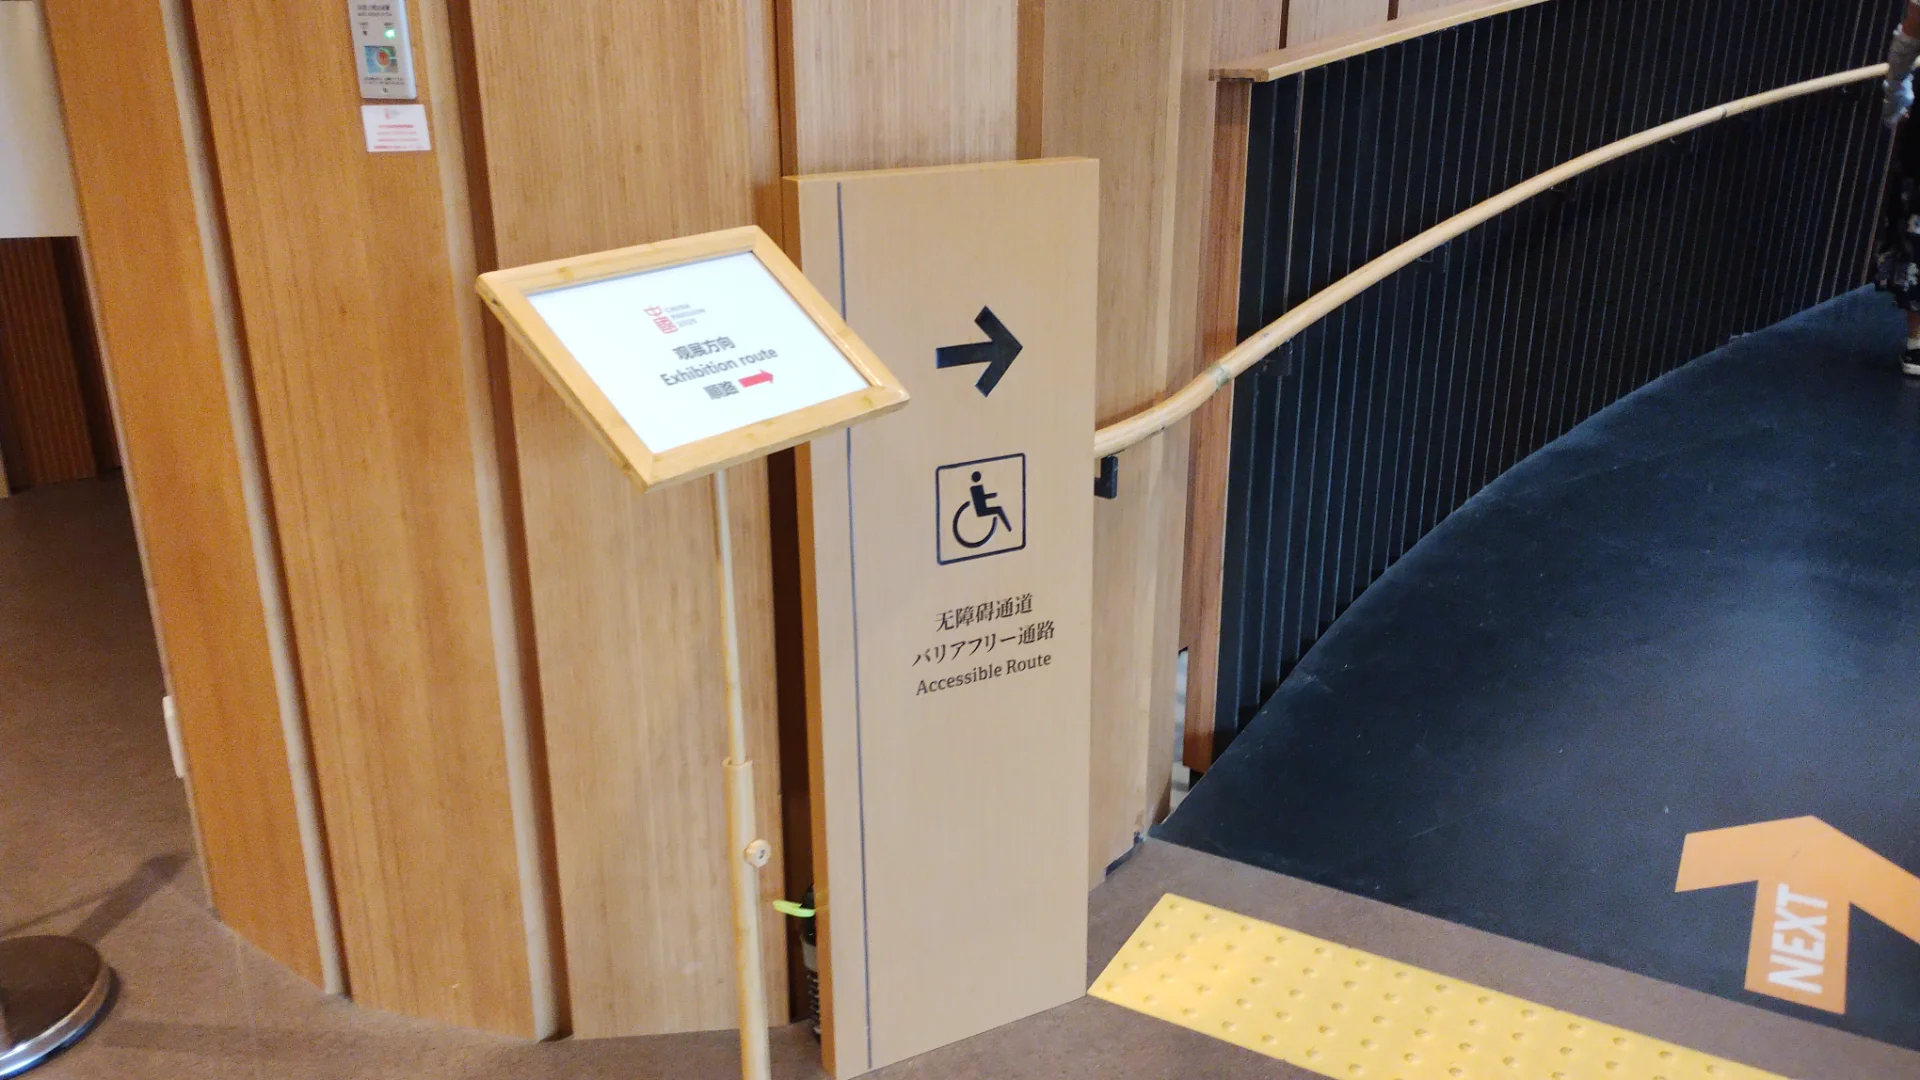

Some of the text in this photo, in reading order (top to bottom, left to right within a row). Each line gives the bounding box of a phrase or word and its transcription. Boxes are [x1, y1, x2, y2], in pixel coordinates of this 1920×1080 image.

[659, 348, 778, 386] Exhibition route
[672, 336, 736, 360] 观展方向
[935, 592, 1033, 632] 无障碍通道
[911, 619, 1055, 667] バリアフリー通路
[915, 654, 1052, 696] Accessible Route
[1767, 882, 1828, 994] NEXT
